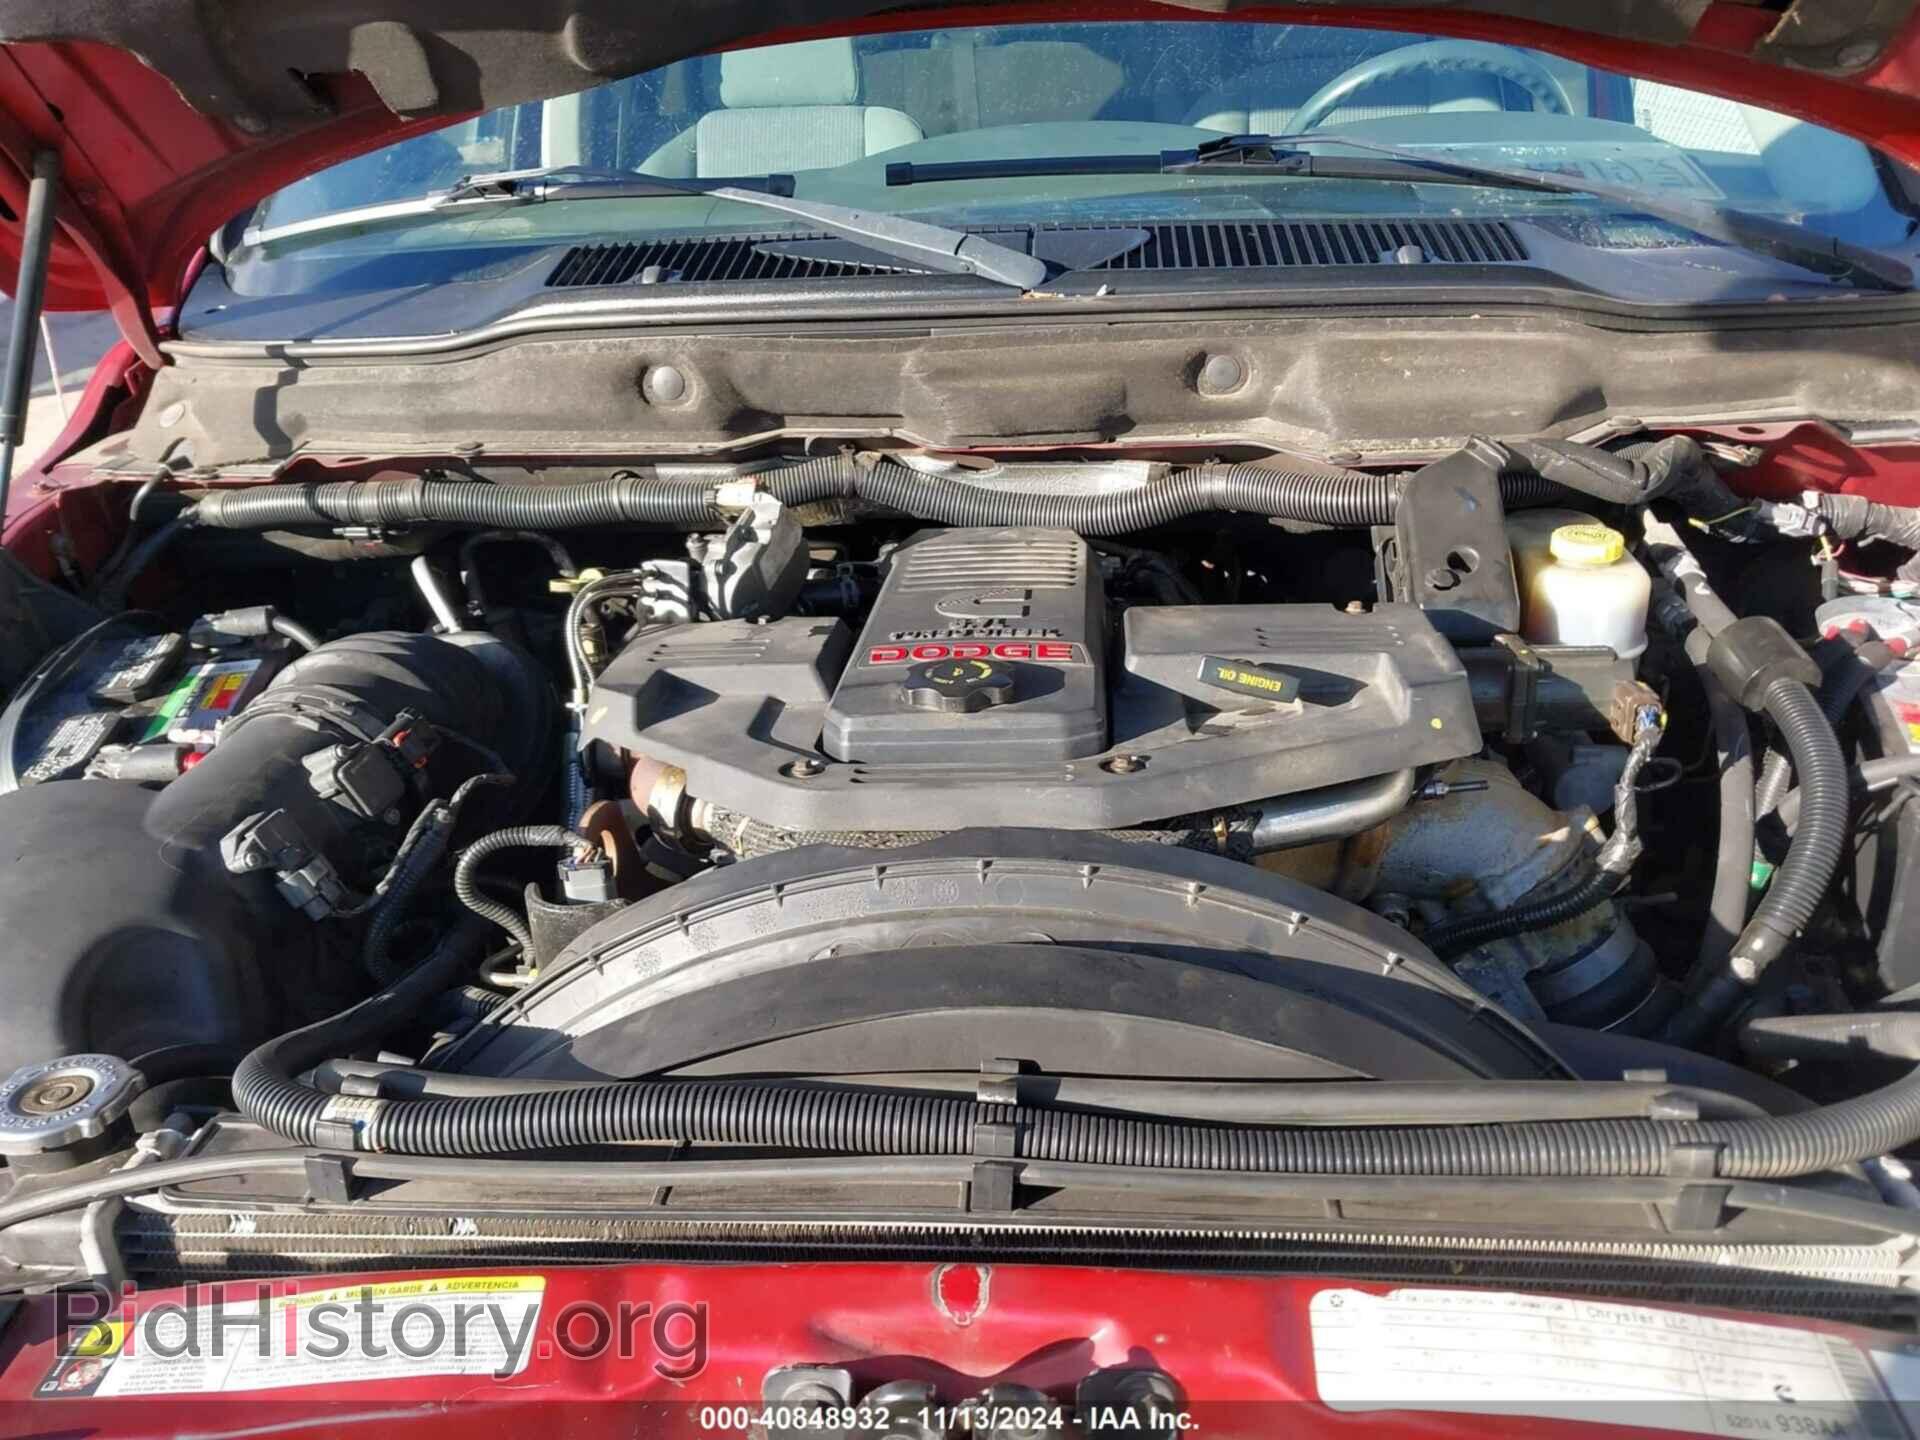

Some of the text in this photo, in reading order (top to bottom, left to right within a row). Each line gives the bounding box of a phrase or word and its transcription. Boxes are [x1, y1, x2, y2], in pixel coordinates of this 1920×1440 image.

[869, 642, 1073, 664] DODGE
[1215, 666, 1283, 692] ENGINE OIL
[446, 1278, 520, 1291] ADVERTENCIA
[1585, 1305, 1655, 1325] Chrysler
